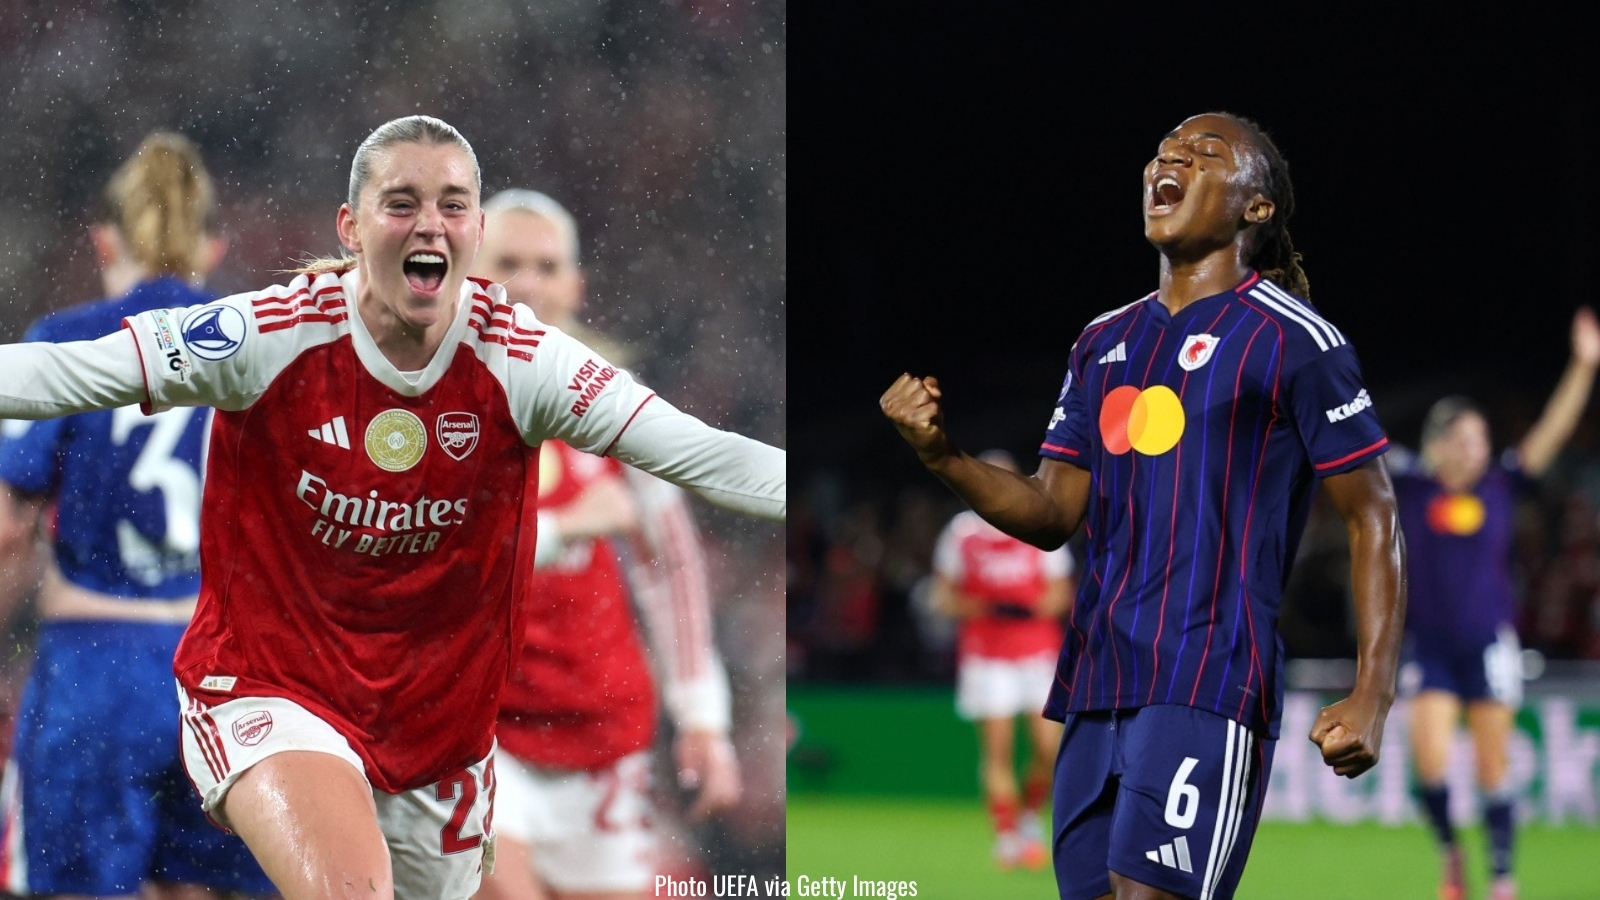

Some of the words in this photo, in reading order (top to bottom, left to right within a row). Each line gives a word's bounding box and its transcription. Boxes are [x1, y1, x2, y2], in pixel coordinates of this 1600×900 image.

[567, 359, 599, 391] VISIT
[442, 420, 473, 429] Arsenal
[296, 469, 468, 532] Emirates
[311, 519, 352, 548] FLY
[354, 531, 441, 556] BETTER
[237, 714, 267, 730] Arsenal
[1164, 757, 1200, 829] 6
